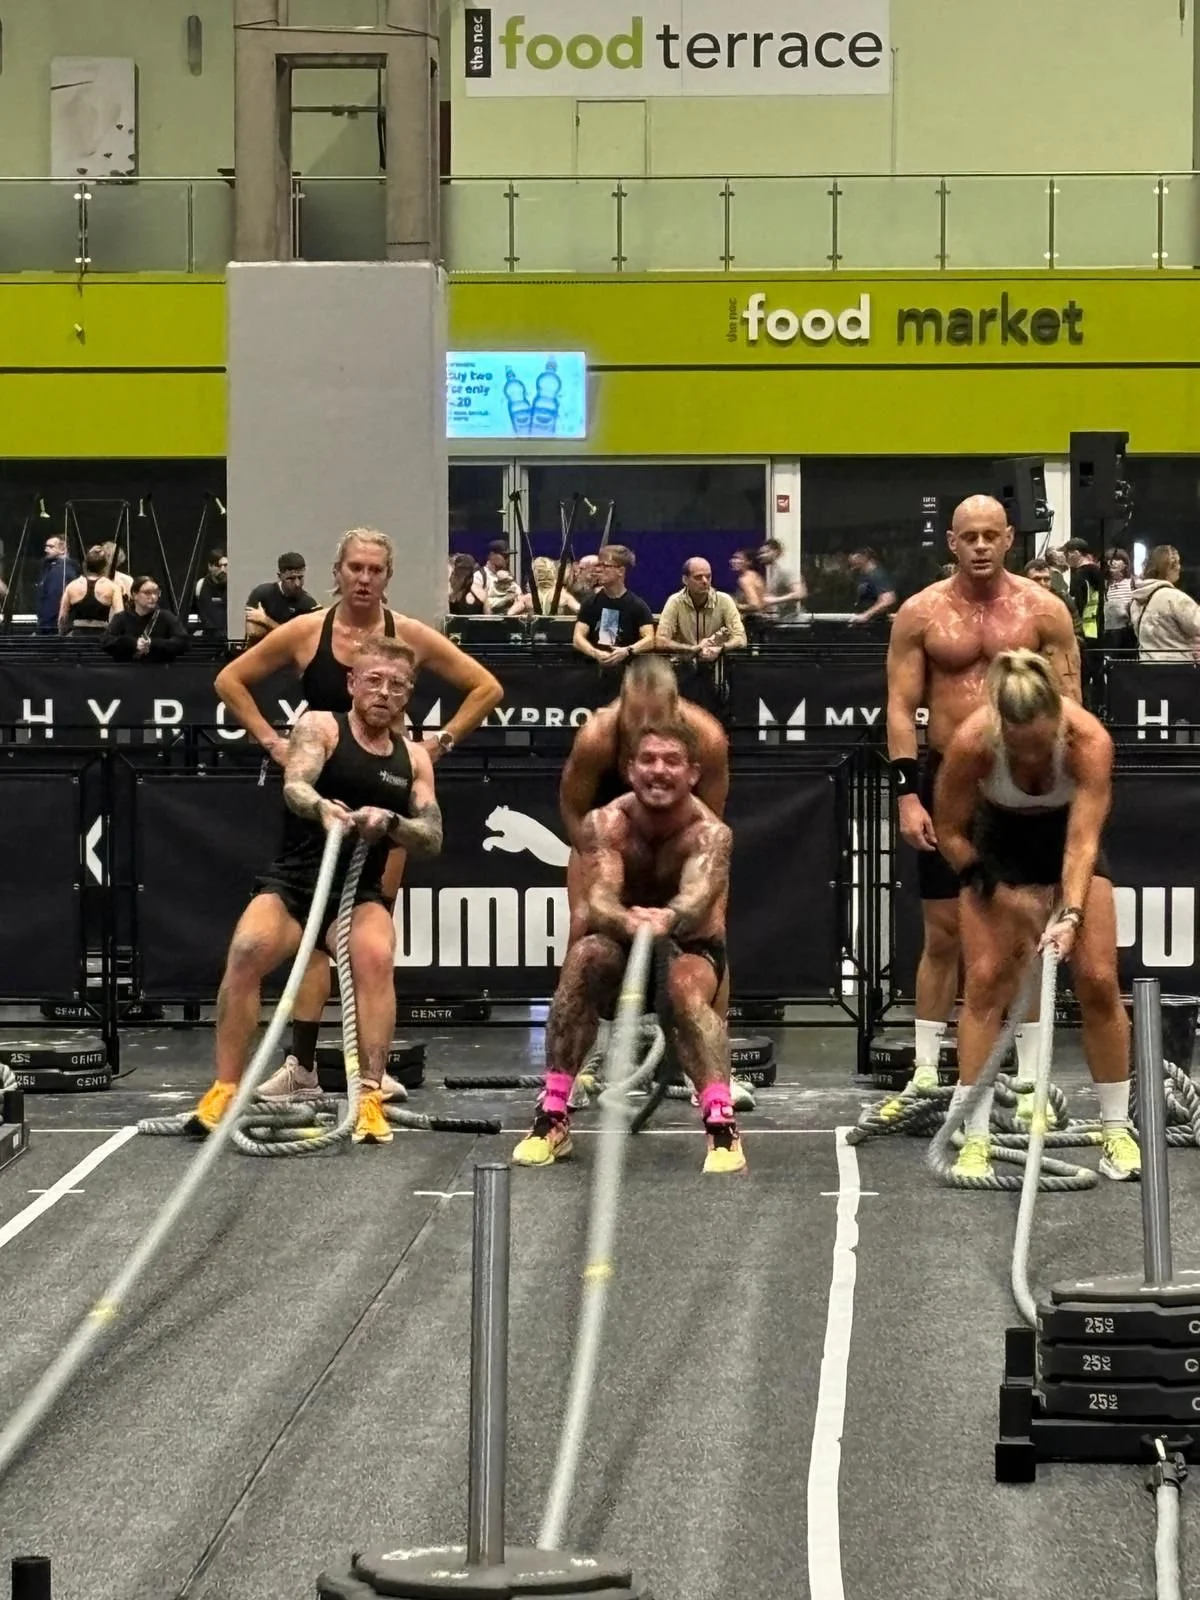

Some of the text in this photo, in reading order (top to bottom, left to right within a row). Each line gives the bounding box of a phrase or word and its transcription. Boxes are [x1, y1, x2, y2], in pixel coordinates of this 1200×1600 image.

[470, 15, 484, 71] the nec
[499, 15, 883, 70] food terrace
[742, 291, 1084, 346] food market
[391, 887, 571, 967] UMA
[410, 1009, 452, 1018] CENTR
[730, 1051, 761, 1061] ENTR
